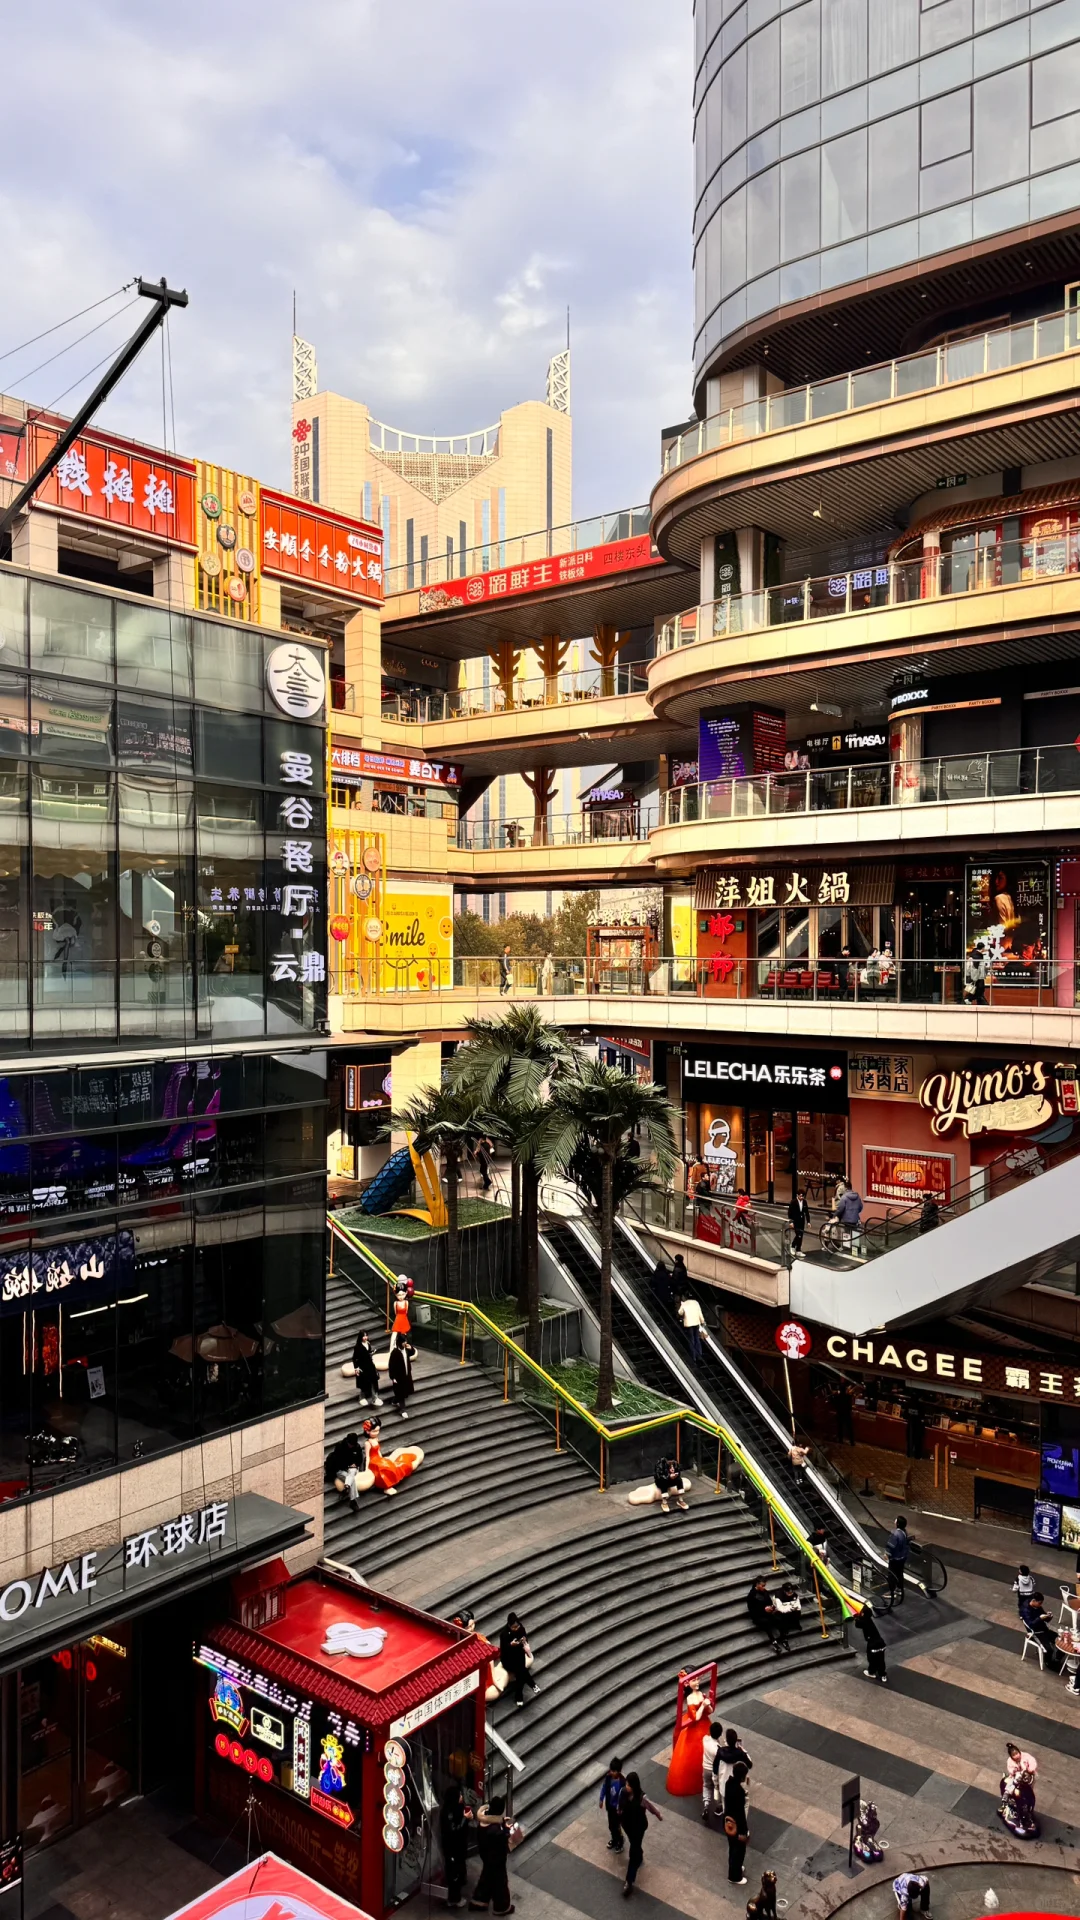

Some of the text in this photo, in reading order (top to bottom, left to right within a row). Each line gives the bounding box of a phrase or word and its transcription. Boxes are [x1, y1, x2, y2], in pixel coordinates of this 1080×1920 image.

[300, 442, 310, 500] 中国联通
[559, 552, 593, 568] 新派日料
[603, 545, 647, 565] 四楼东头
[559, 569, 585, 581] 铁板烧
[806, 737, 829, 748] 电梯厅
[331, 750, 361, 768] 大排档
[586, 908, 648, 927] 公路夜市
[271, 951, 326, 982] 云鼎
[684, 1060, 826, 1087] LELECHA 乐乐茶
[860, 1073, 909, 1092] 烤肉店
[703, 1156, 736, 1166] LELECHA
[826, 1335, 1080, 1397] CHAGEE 霸王
[125, 1501, 229, 1569] 环球店
[414, 1676, 472, 1723] 中国体育彩票
